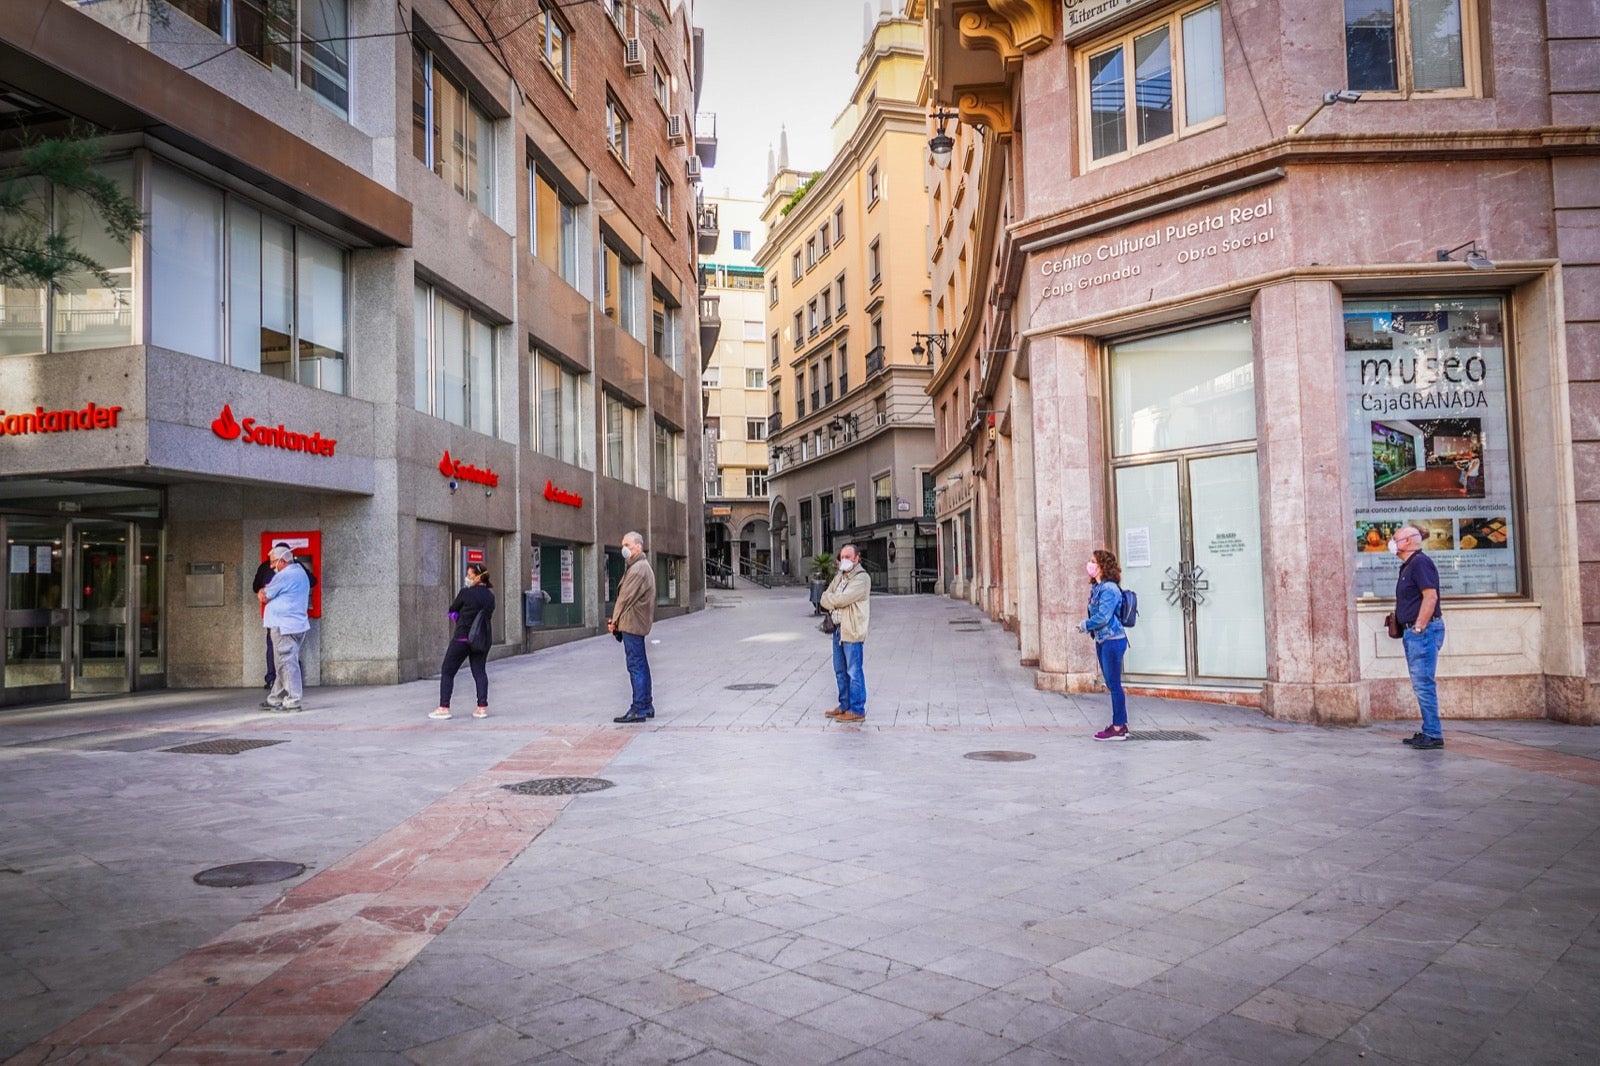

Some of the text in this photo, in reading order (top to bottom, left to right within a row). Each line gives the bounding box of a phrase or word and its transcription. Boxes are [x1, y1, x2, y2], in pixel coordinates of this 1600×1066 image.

[1041, 198, 1274, 276] Centro Cultural Puerta Real
[1042, 280, 1073, 298] Caja
[1078, 264, 1141, 289] Granada
[1177, 243, 1217, 264] Obra
[1222, 227, 1275, 252] Social
[1361, 355, 1487, 385] museo
[1361, 390, 1489, 414] CajaGRANADA
[242, 417, 337, 457] Santander
[453, 459, 499, 488] Santander
[1355, 507, 1369, 516] para
[1433, 504, 1446, 512] con
[1447, 503, 1466, 511] todos
[1467, 502, 1477, 511] los
[1479, 502, 1506, 511] sentidos
